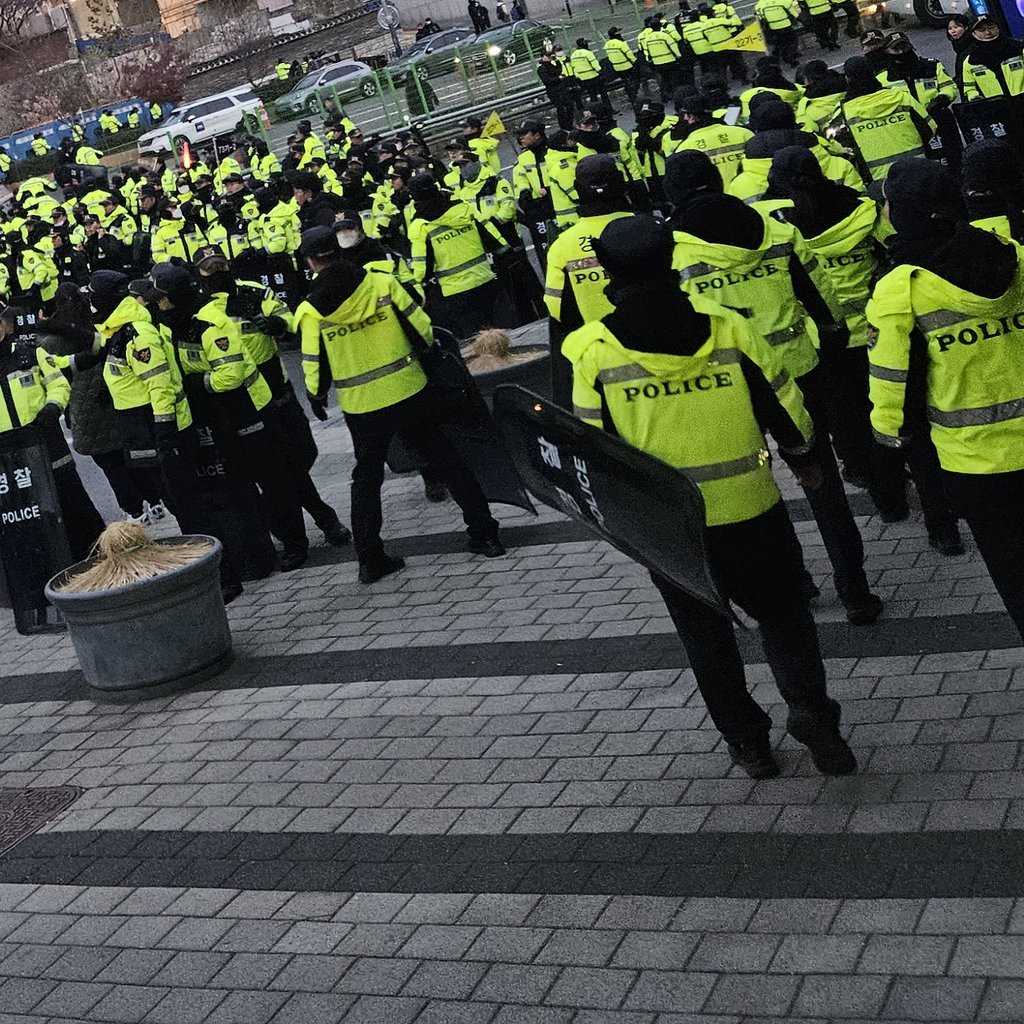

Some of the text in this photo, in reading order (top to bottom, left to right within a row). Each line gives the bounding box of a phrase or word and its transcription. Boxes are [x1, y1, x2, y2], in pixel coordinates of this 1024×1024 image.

[857, 115, 906, 132] POLICE
[714, 153, 744, 165] LICE
[436, 224, 475, 244] POLICE
[696, 263, 778, 294] POLICE
[328, 311, 388, 341] POLICE
[623, 372, 733, 403] POLICE
[1, 504, 41, 524] POLICE
